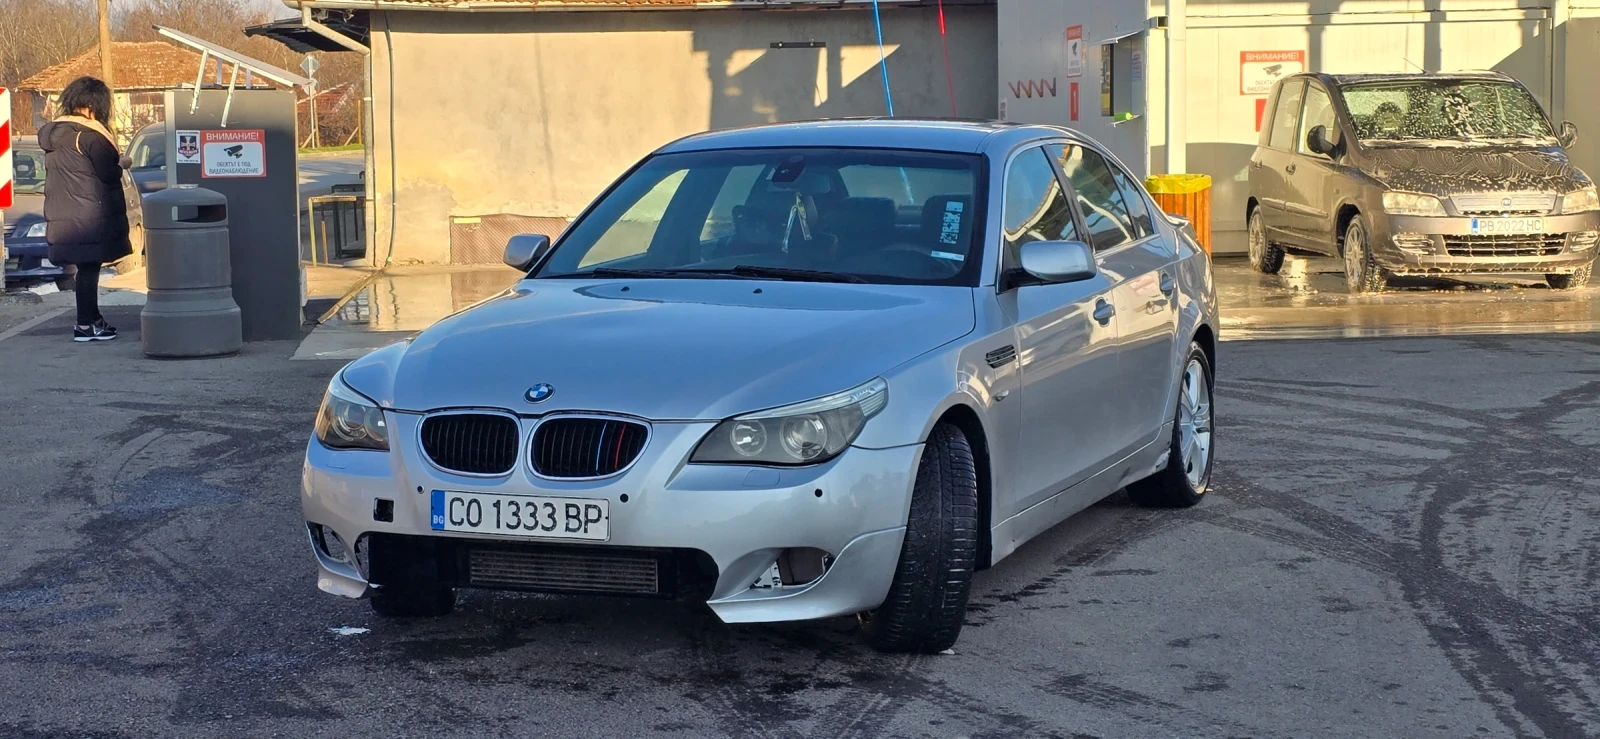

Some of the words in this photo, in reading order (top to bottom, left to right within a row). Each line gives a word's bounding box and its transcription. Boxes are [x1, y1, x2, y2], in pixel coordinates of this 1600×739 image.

[1246, 52, 1299, 61] ВНИМАНИЕ!
[206, 132, 259, 141] ВНИМАНИЕ!
[1480, 221, 1495, 232] PB
[1497, 221, 1524, 232] 2022
[1527, 220, 1541, 231] HC
[433, 515, 444, 524] BG
[450, 497, 482, 527] CO
[493, 499, 557, 532] 1333
[565, 503, 602, 534] BP
